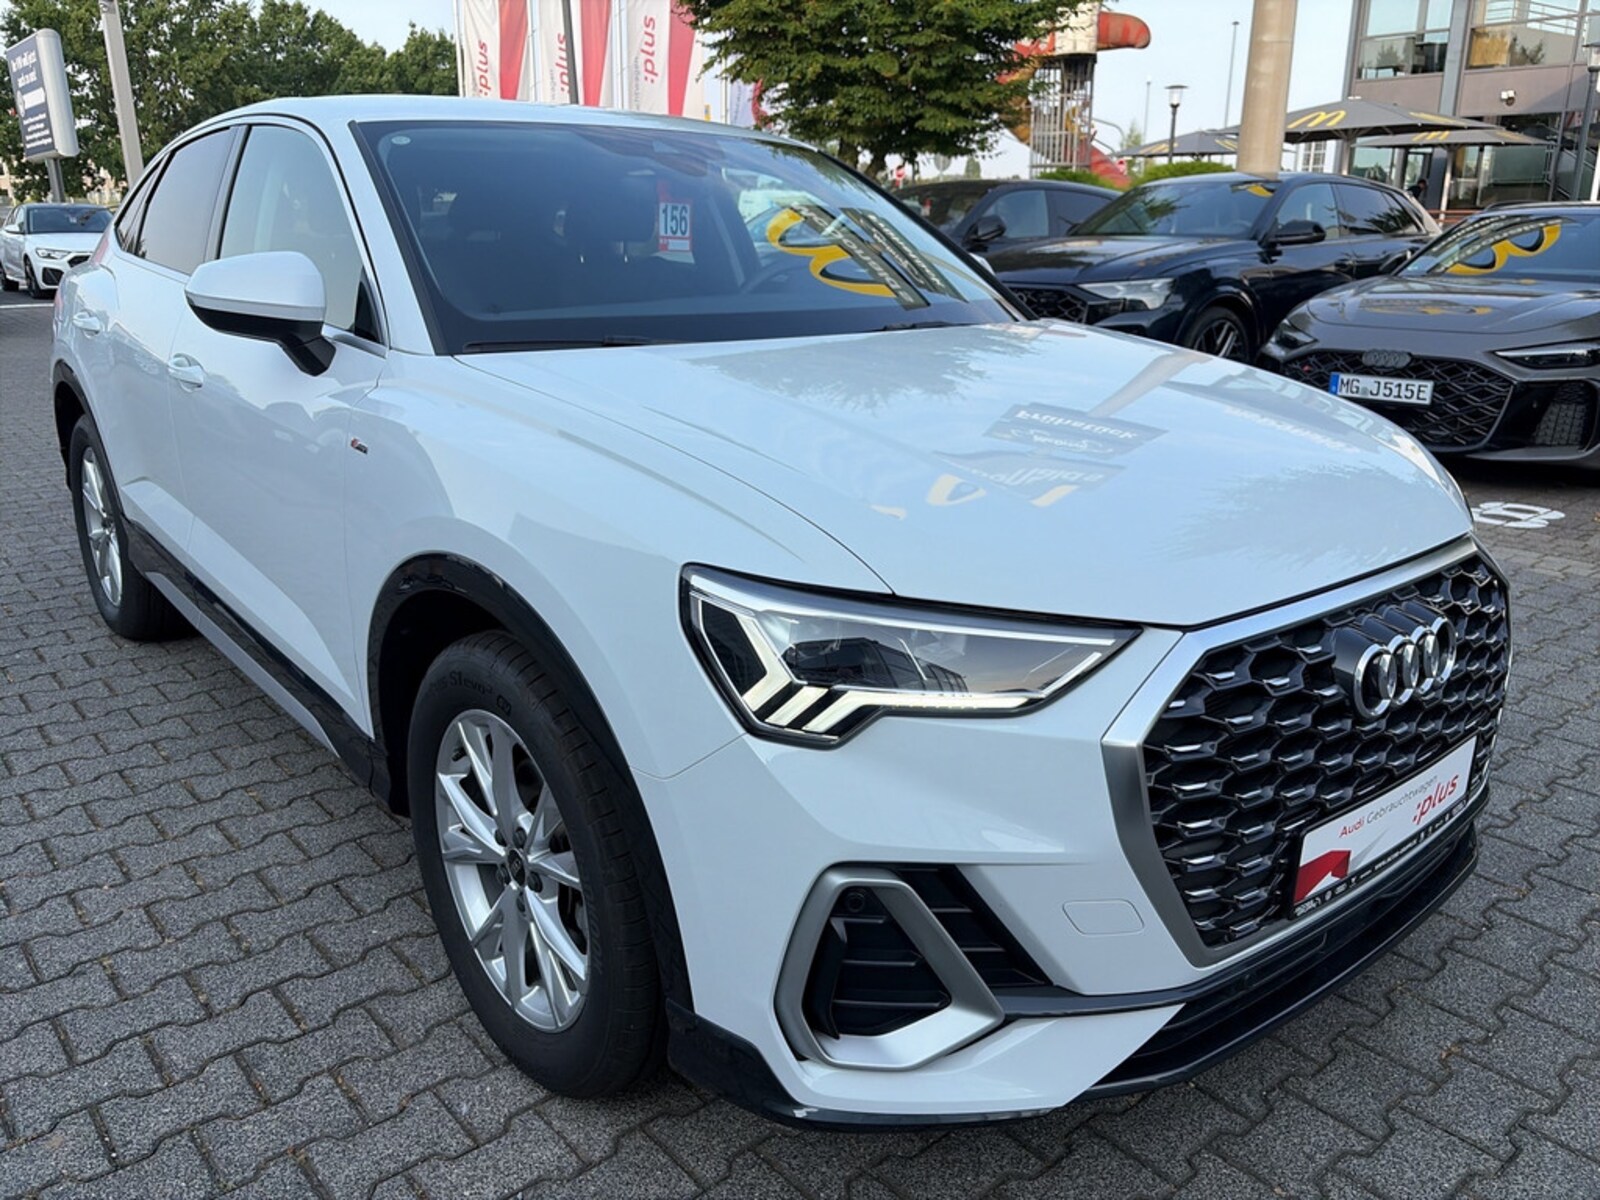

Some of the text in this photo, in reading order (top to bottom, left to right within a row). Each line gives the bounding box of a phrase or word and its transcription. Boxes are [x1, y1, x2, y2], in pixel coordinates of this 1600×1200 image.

[476, 40, 490, 97] :plus
[640, 15, 658, 84] :plus
[662, 203, 688, 236] 156
[1339, 377, 1429, 401] MG J515E
[1412, 774, 1460, 826] :plus
[1339, 815, 1366, 838] Audi
